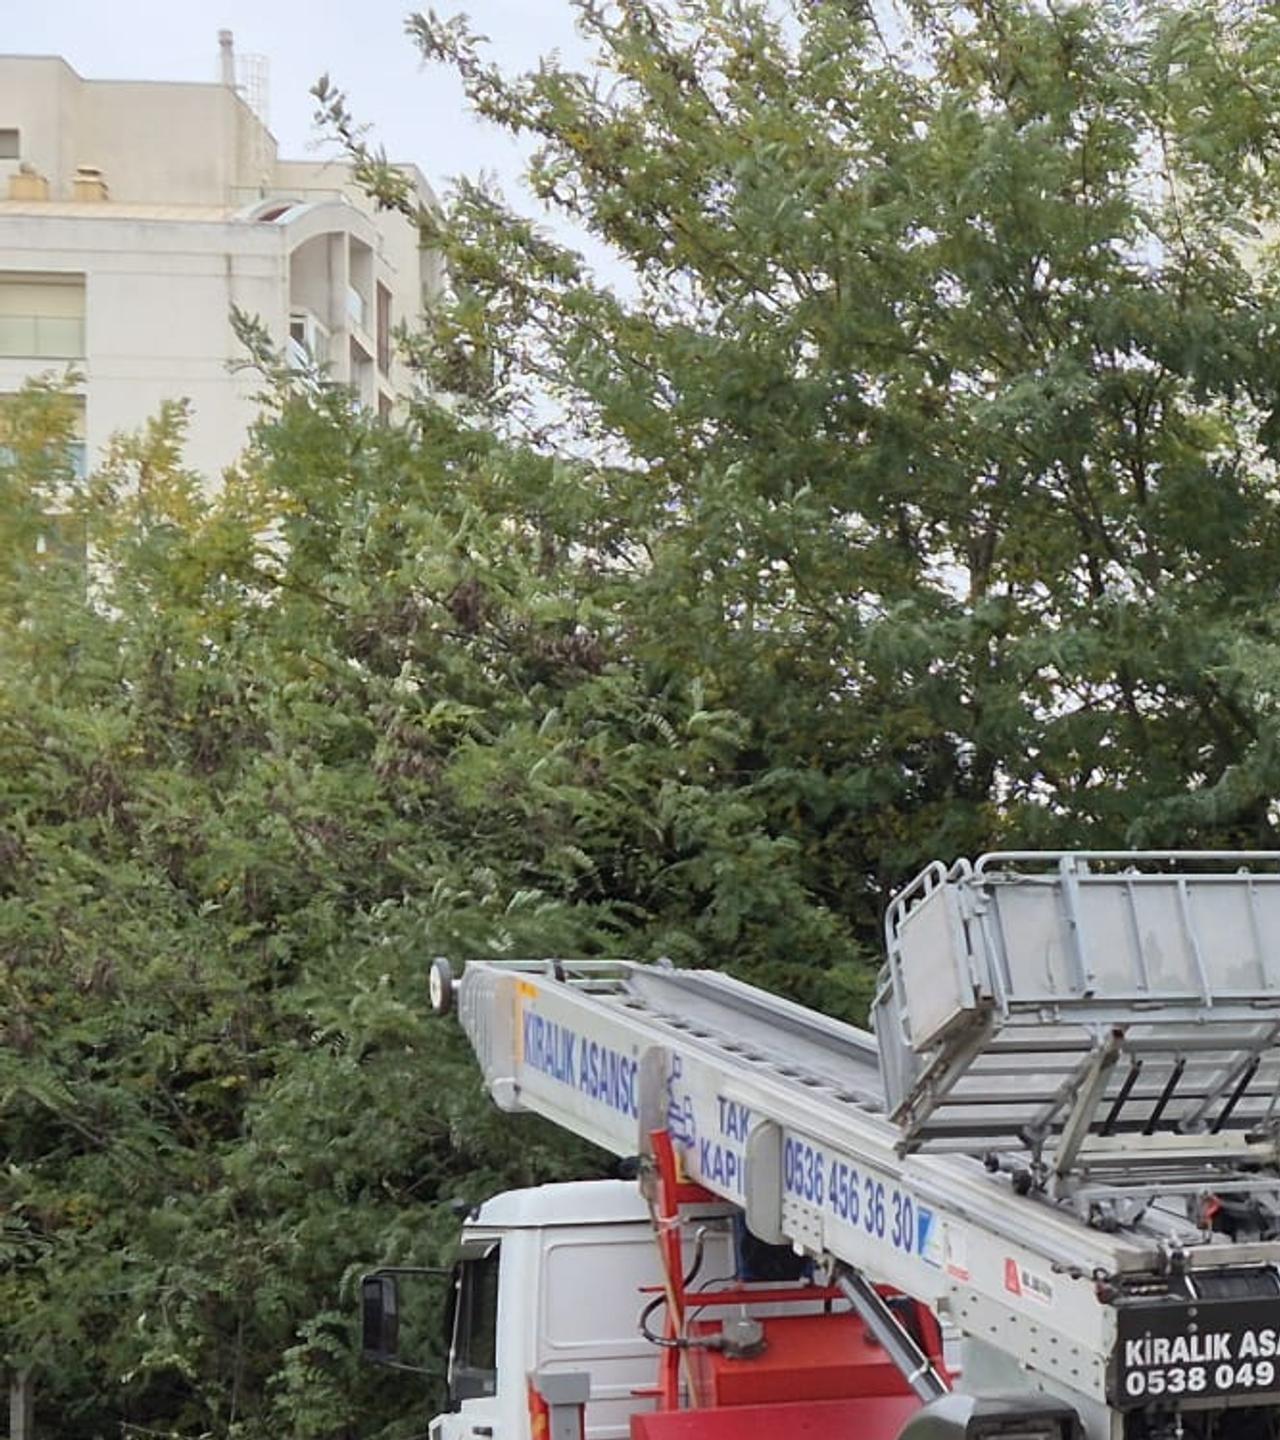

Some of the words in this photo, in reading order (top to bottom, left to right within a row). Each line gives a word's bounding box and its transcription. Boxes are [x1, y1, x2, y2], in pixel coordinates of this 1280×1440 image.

[784, 1137, 824, 1205] 0536
[829, 1161, 859, 1225] 456
[864, 1179, 885, 1238] 36
[892, 1190, 913, 1252] 30
[1125, 1331, 1231, 1367] KİRALIK
[1126, 1367, 1207, 1396] 0538
[1215, 1361, 1274, 1389] 049
